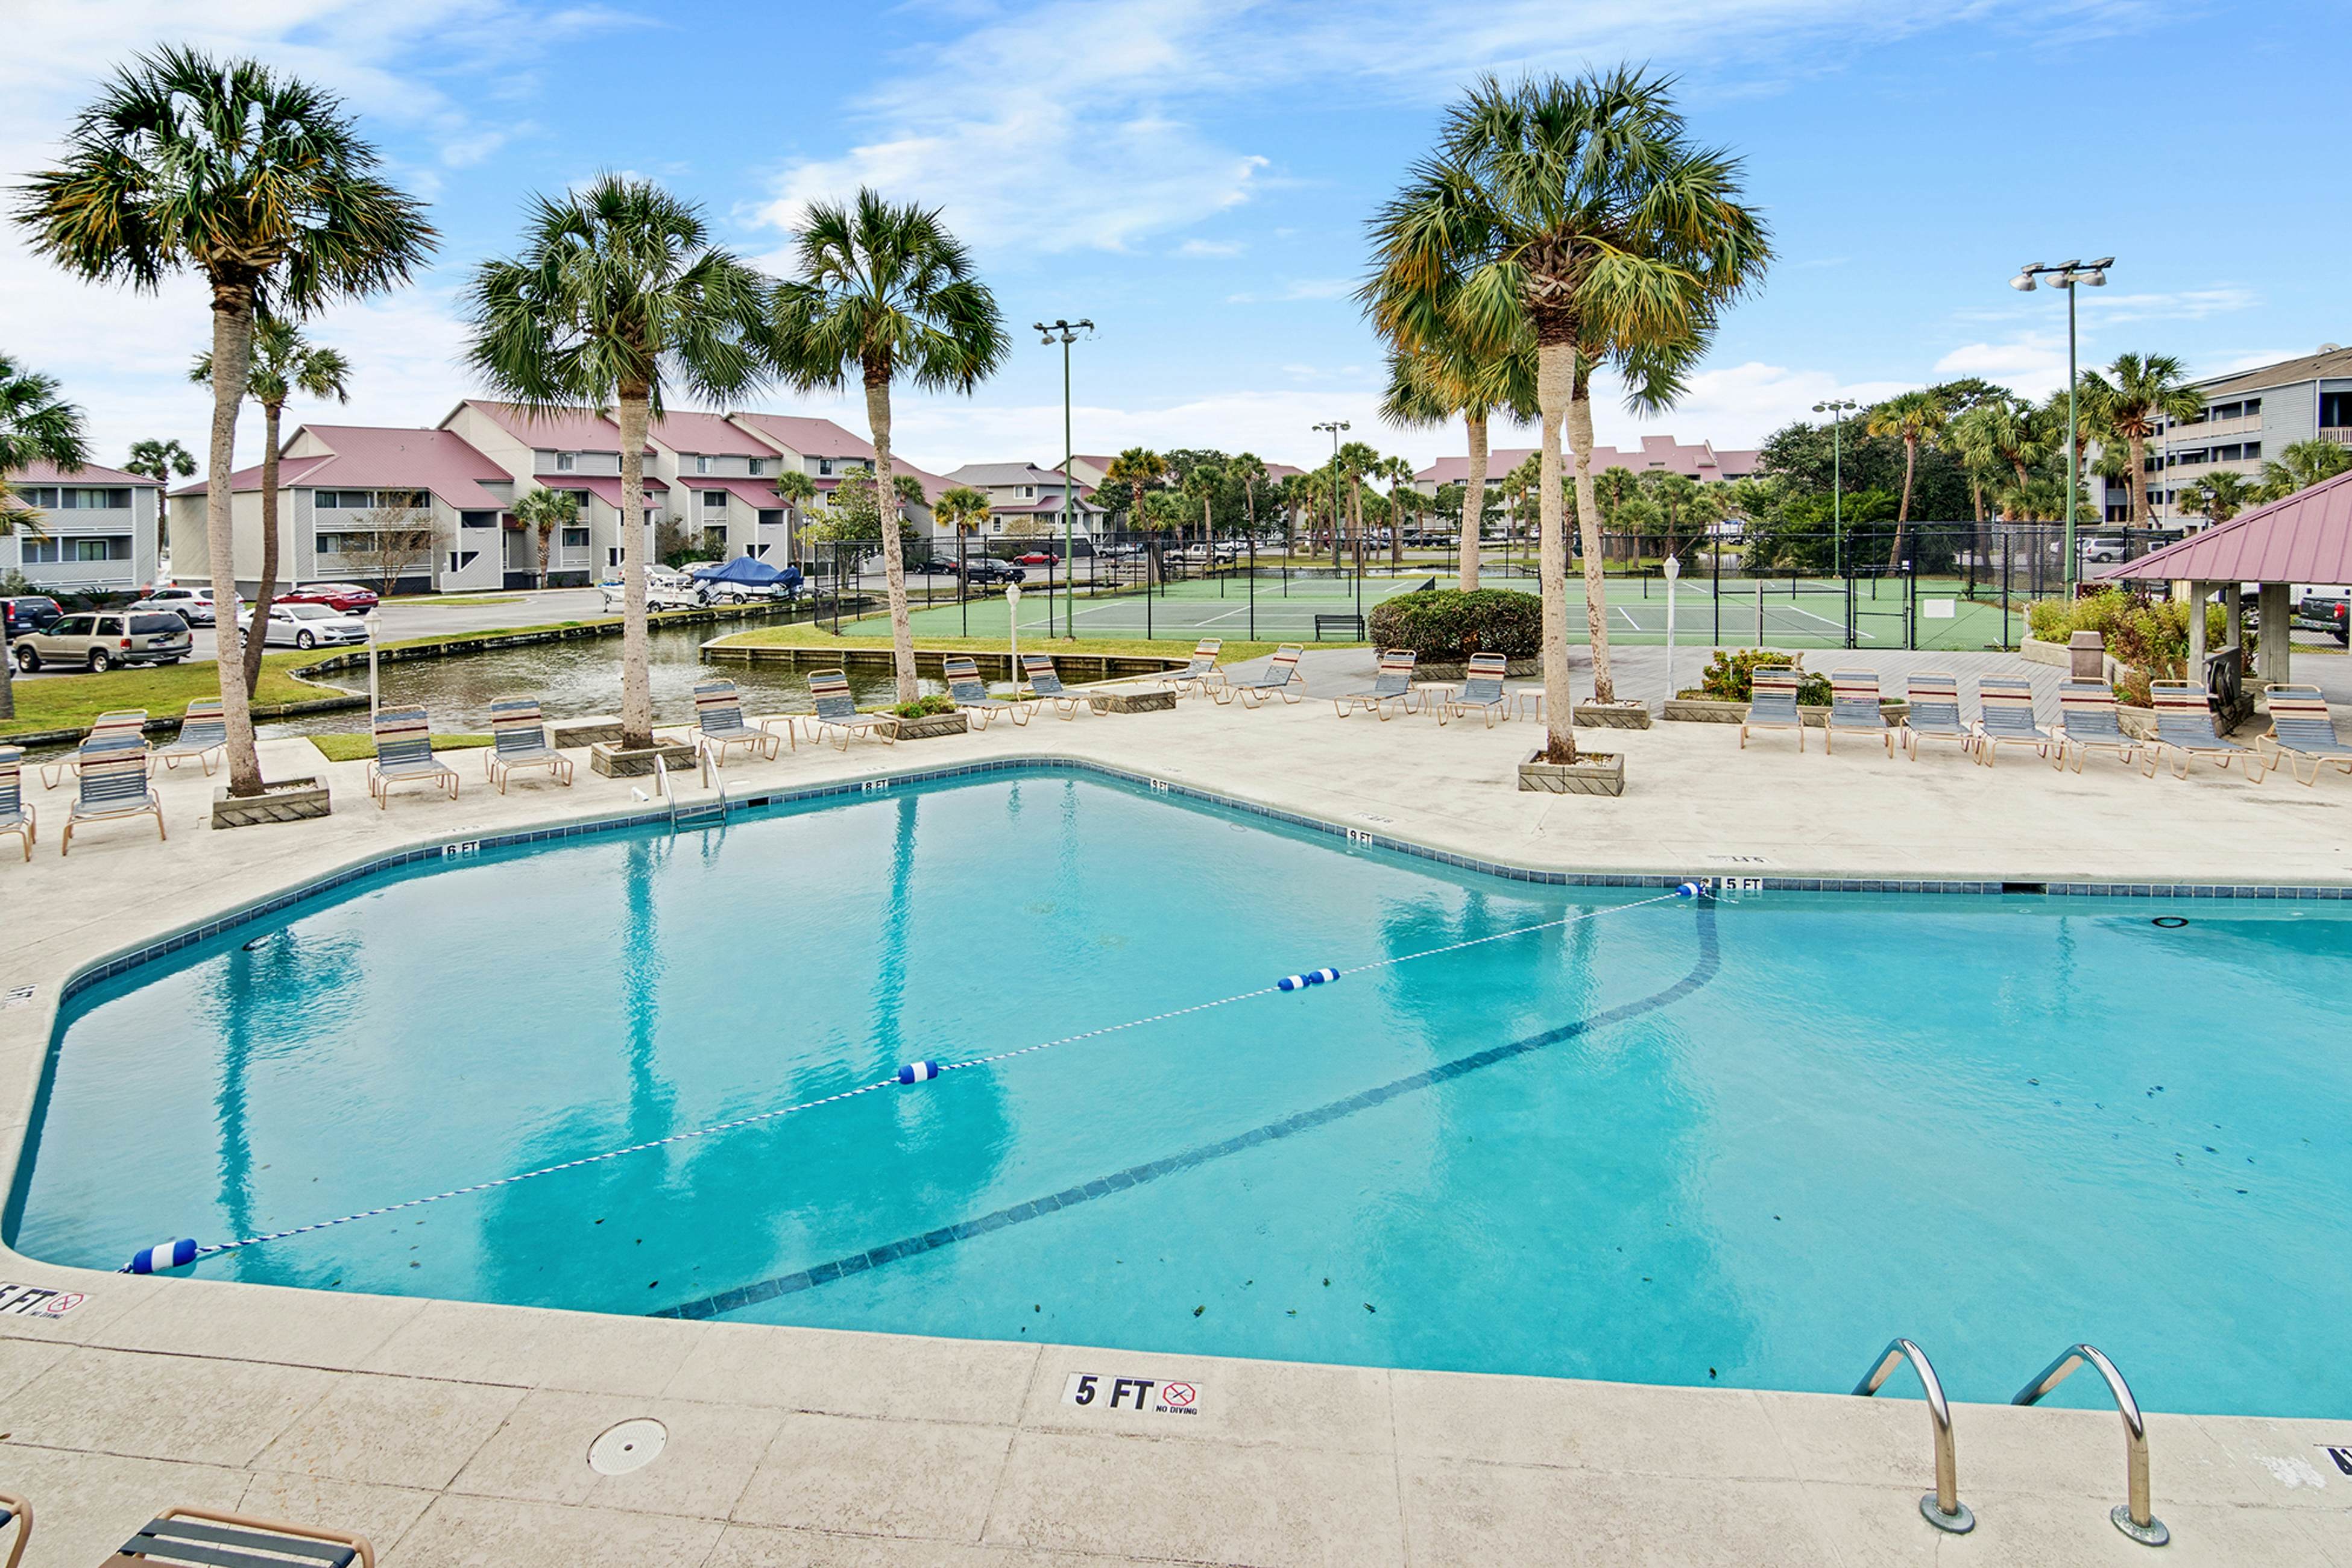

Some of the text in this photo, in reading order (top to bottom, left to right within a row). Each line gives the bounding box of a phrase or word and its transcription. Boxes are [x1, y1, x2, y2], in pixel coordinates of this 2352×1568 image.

[1350, 830, 1371, 843] 9 FT
[462, 842, 478, 852] FT
[1727, 878, 1761, 889] 5 FT
[0, 1288, 59, 1314] FT
[1075, 1375, 1155, 1410] 5 FT
[1156, 1405, 1197, 1415] NO DIVING
